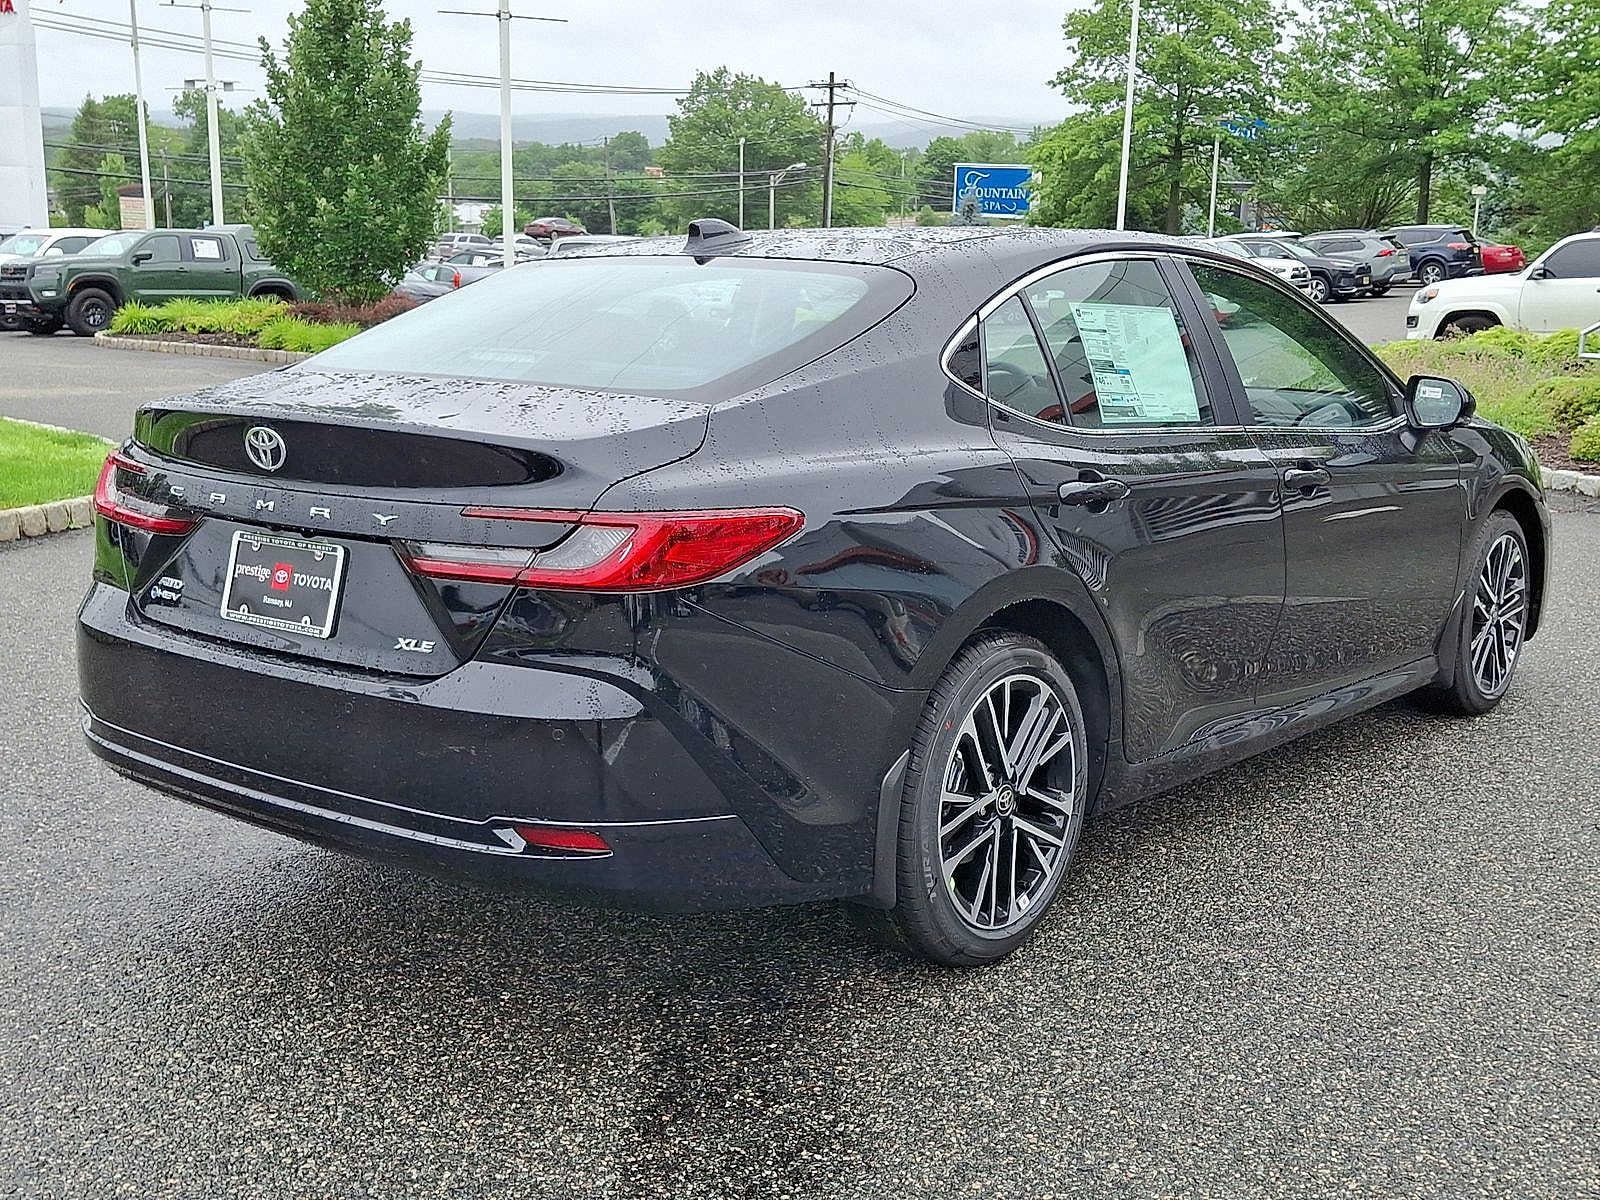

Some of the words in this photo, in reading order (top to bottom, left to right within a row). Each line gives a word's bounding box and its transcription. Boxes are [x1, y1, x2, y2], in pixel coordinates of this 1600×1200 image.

[959, 171, 1027, 199] FOUNTAIN
[984, 201, 1001, 210] SPA
[169, 485, 399, 526] CAMRY
[243, 534, 270, 543] PRESTIGE
[307, 544, 333, 552] RAMSEY
[234, 563, 272, 582] prestige
[293, 573, 333, 591] TOYOTA
[393, 637, 436, 654] XLE
